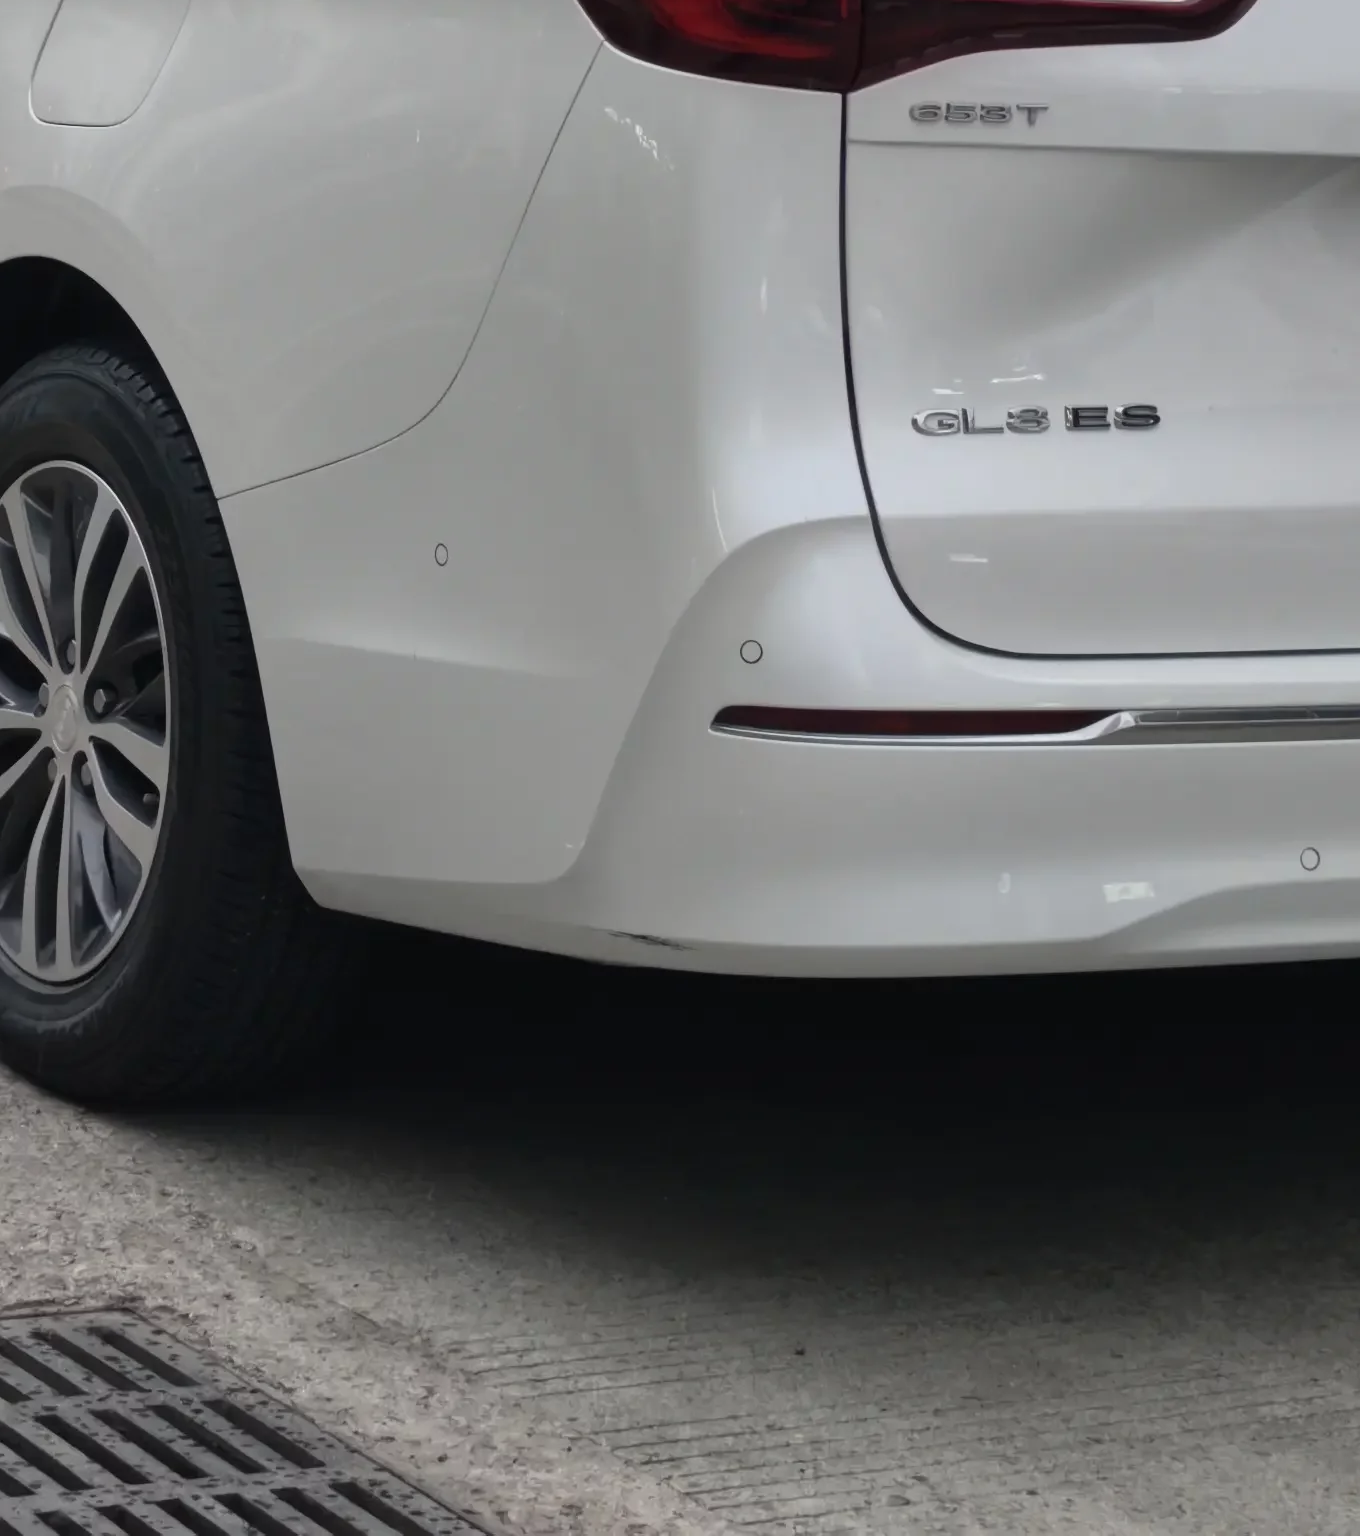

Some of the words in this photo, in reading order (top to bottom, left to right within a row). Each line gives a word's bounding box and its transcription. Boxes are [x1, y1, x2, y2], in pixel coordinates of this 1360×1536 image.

[909, 102, 1049, 128] 653T
[911, 407, 1050, 436] GL8
[1064, 404, 1161, 432] ES
